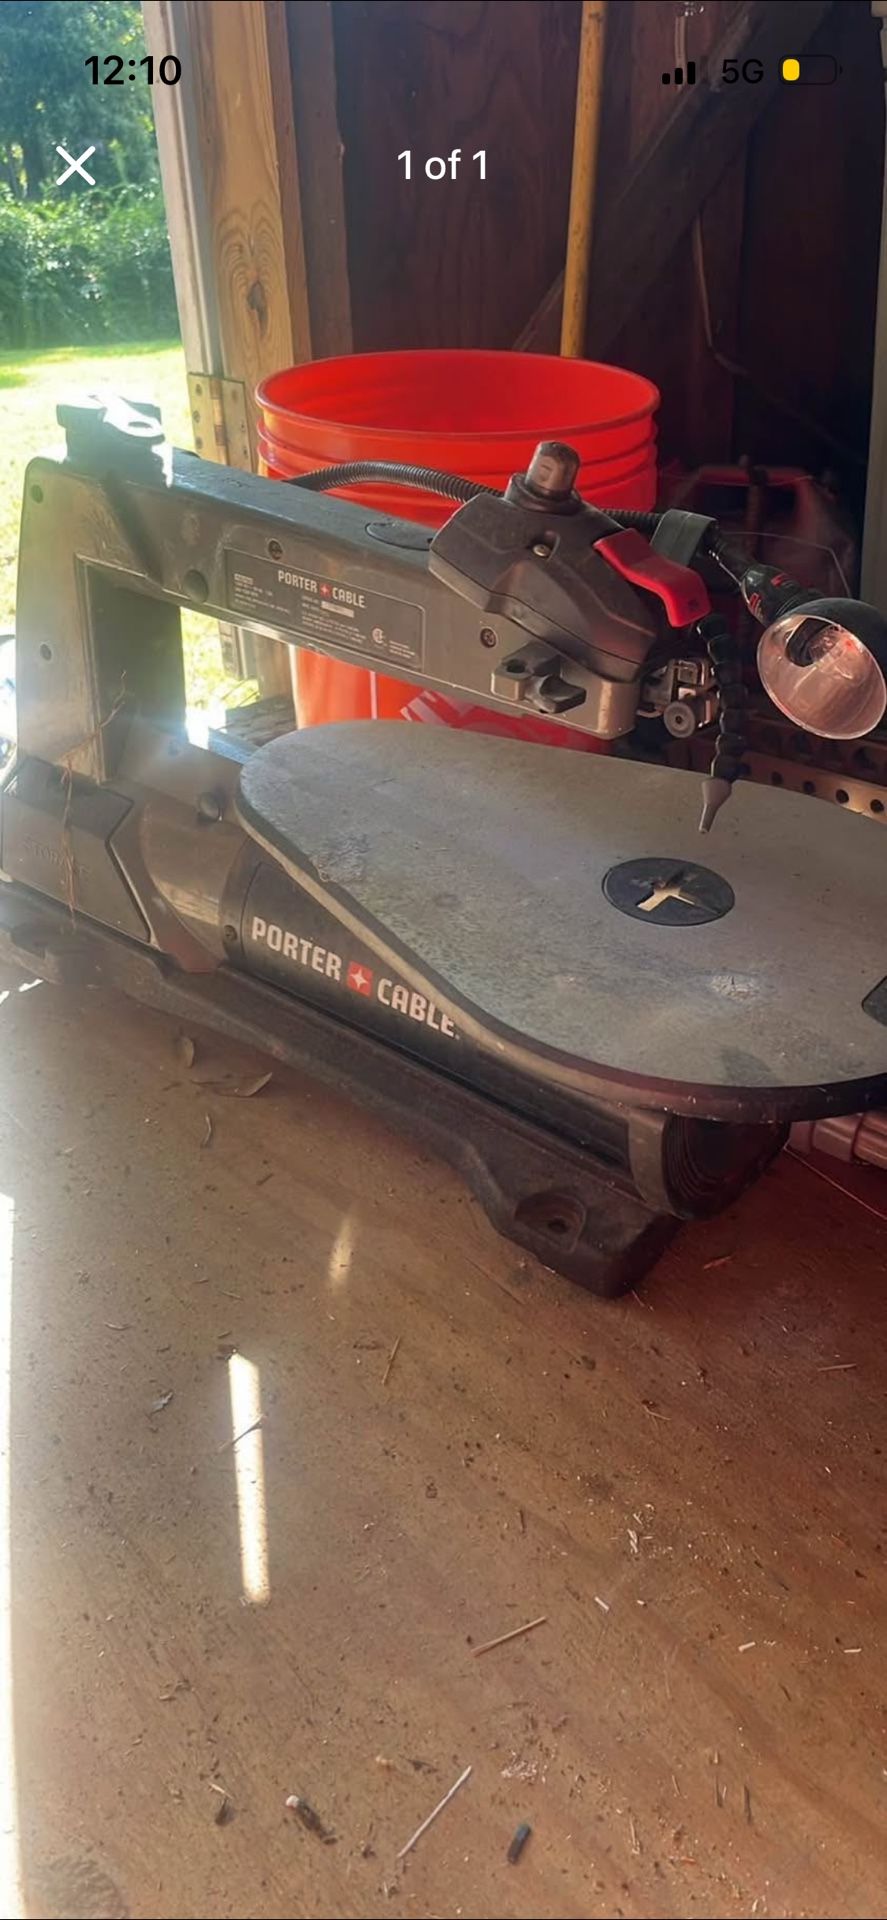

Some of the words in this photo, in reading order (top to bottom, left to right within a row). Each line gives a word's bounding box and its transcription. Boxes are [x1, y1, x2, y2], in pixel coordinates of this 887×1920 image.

[278, 570, 318, 595] PORTER
[332, 587, 366, 609] CABLE
[251, 916, 343, 981] PORTER
